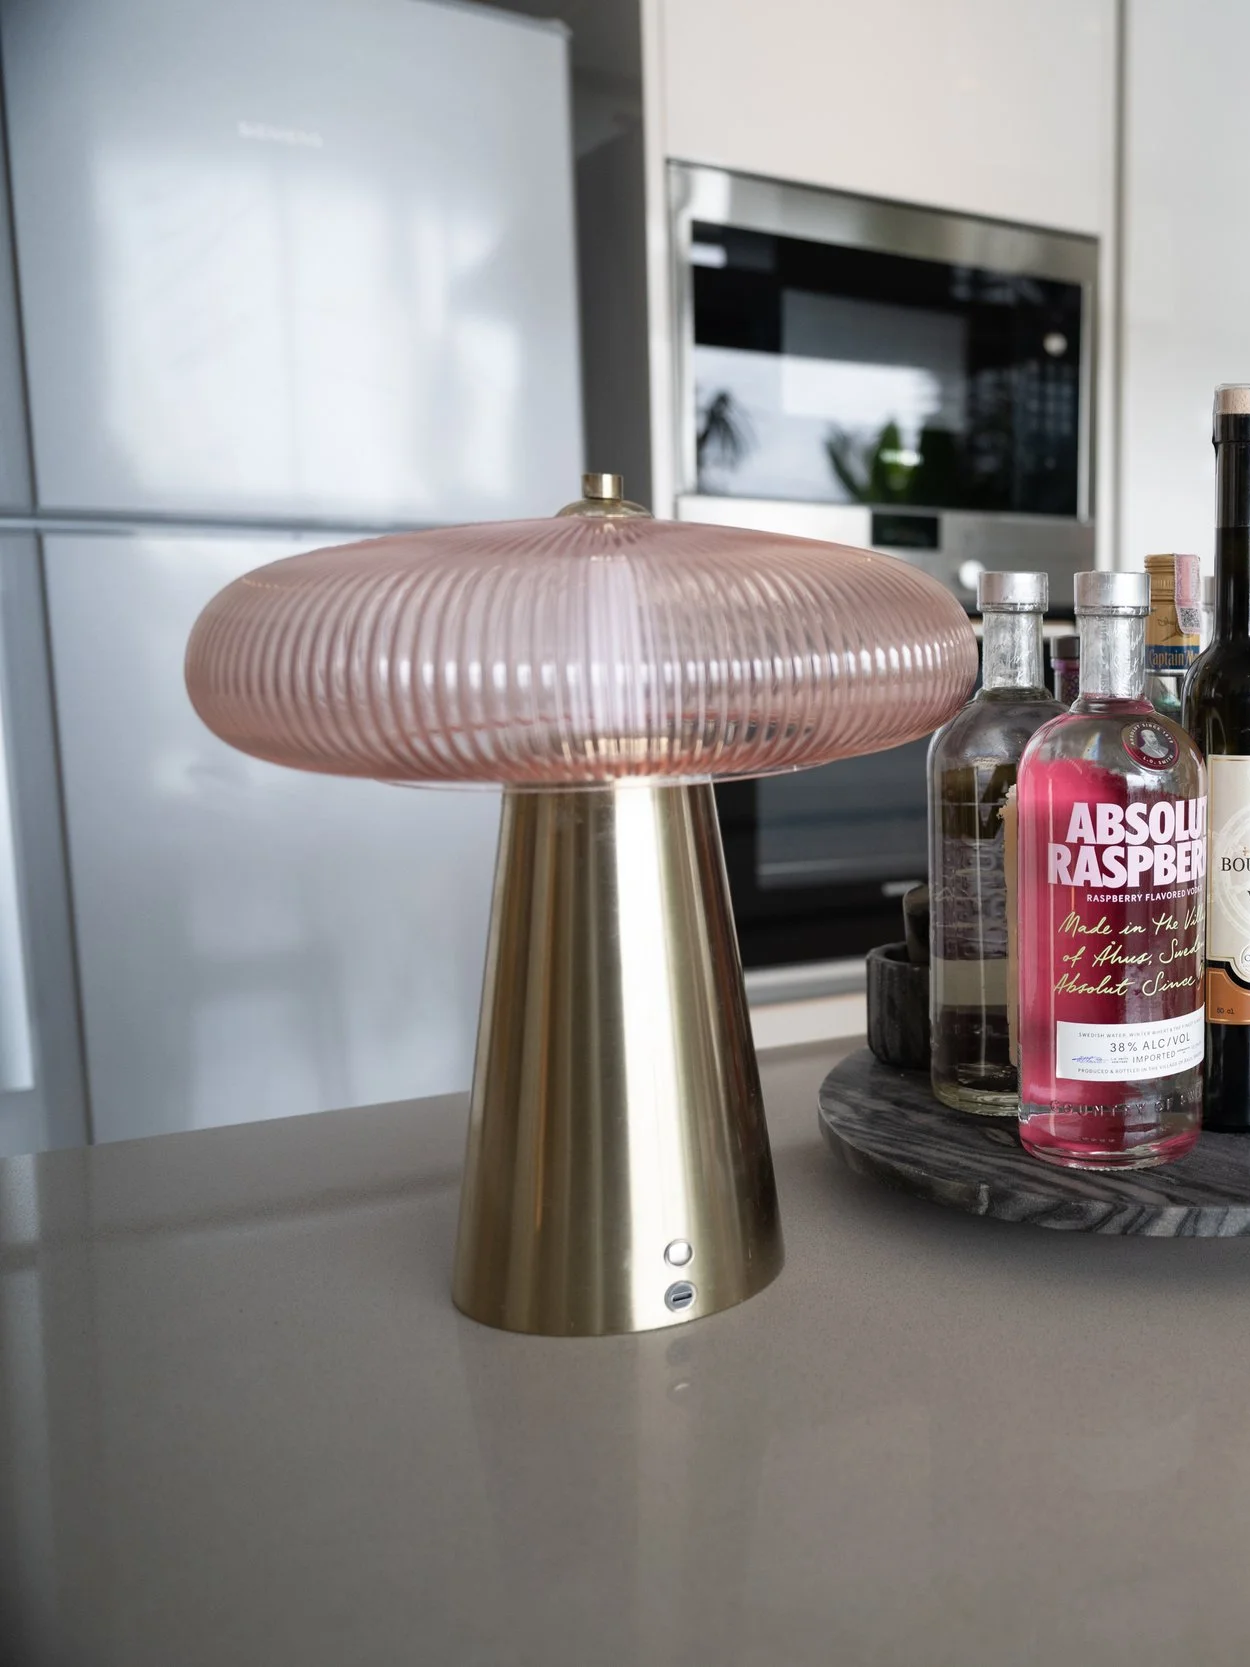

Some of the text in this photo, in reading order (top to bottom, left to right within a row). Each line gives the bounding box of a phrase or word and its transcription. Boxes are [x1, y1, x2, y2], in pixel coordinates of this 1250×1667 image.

[1086, 893, 1142, 903] RASPBERRY
[1145, 889, 1186, 901] FLAVORED
[1058, 911, 1113, 938] Made
[1119, 921, 1146, 935] in
[1152, 912, 1179, 936] the
[1062, 946, 1087, 967] of
[1053, 973, 1135, 996] Absolut
[1142, 971, 1196, 996] Since
[1110, 1041, 1138, 1053] 38%
[1142, 1032, 1190, 1051] ALC/VOL
[1132, 1050, 1176, 1063] IMPORTED
